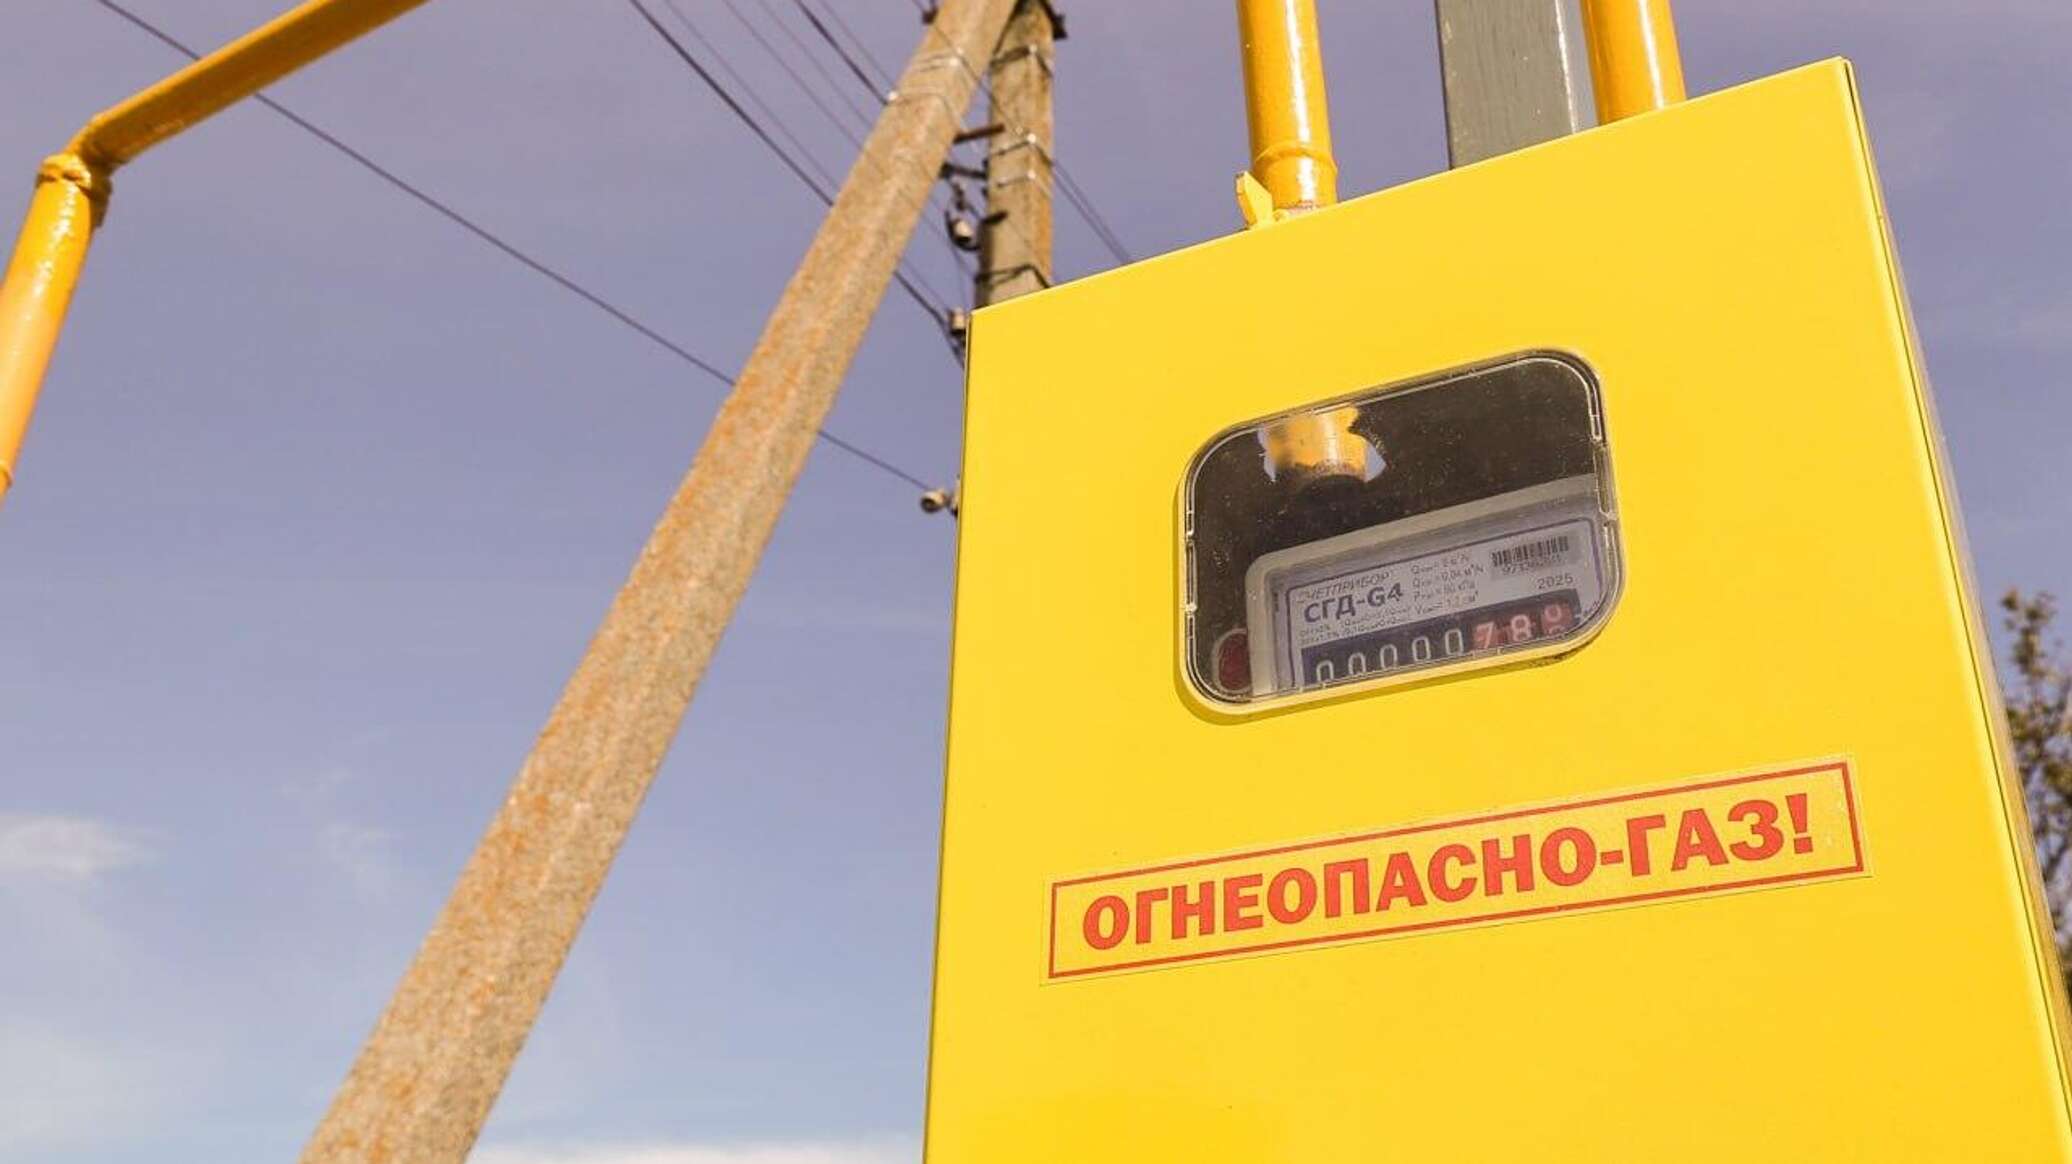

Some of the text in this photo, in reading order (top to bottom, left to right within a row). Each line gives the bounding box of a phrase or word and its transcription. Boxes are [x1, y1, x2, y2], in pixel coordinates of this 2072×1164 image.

[1537, 572, 1574, 590] 2025
[1304, 583, 1403, 623] СГД-G4
[1082, 793, 1815, 951] ОГНЕОПАСНО-ГАЗ!
